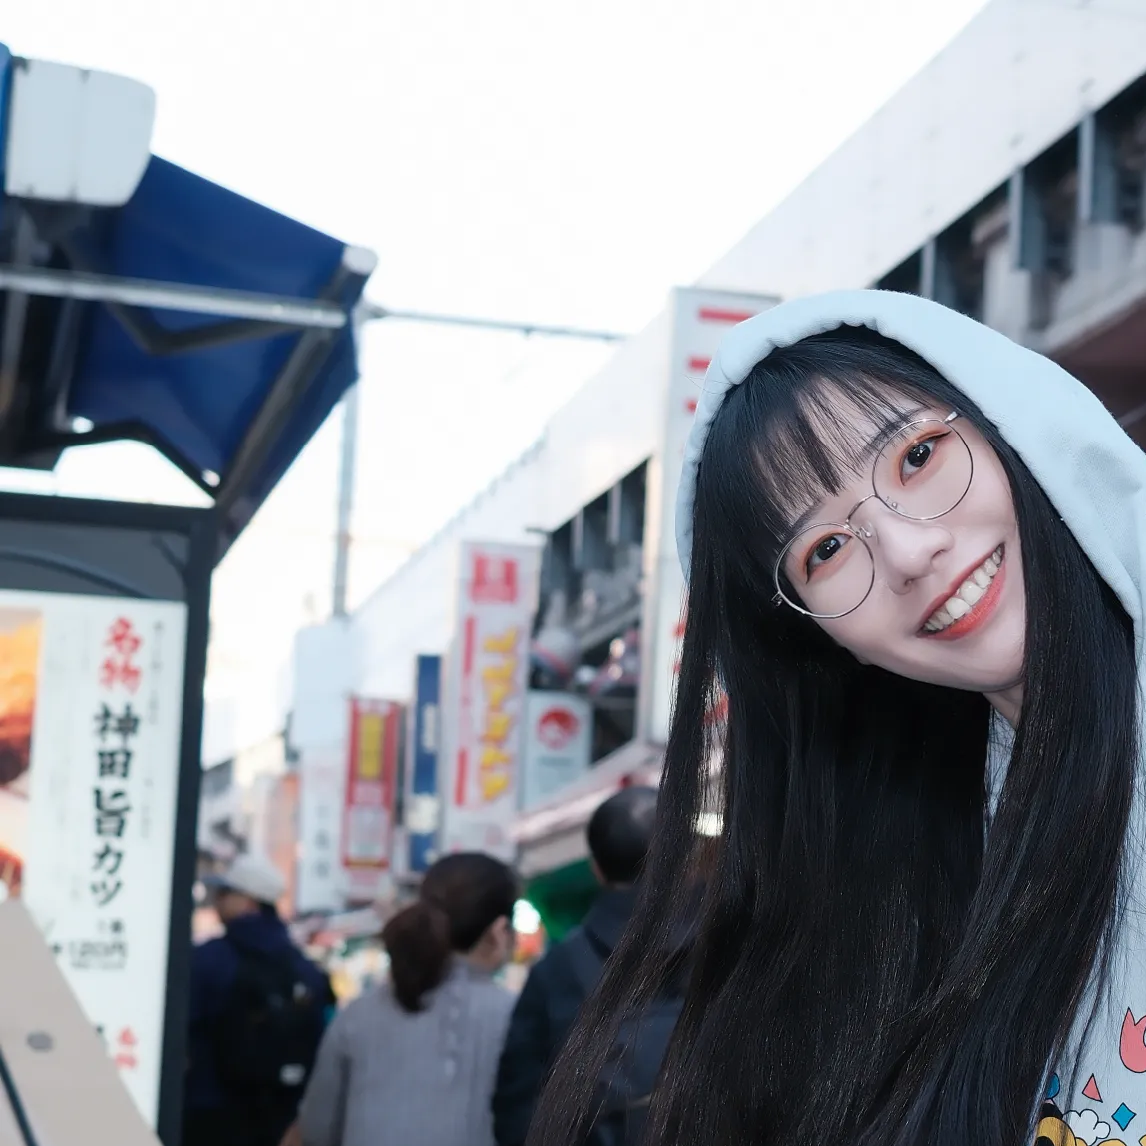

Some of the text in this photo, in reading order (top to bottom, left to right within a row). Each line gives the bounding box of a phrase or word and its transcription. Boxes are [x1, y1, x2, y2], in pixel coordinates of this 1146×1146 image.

[102, 616, 143, 693] 名物
[90, 702, 140, 907] 神田旨カツ
